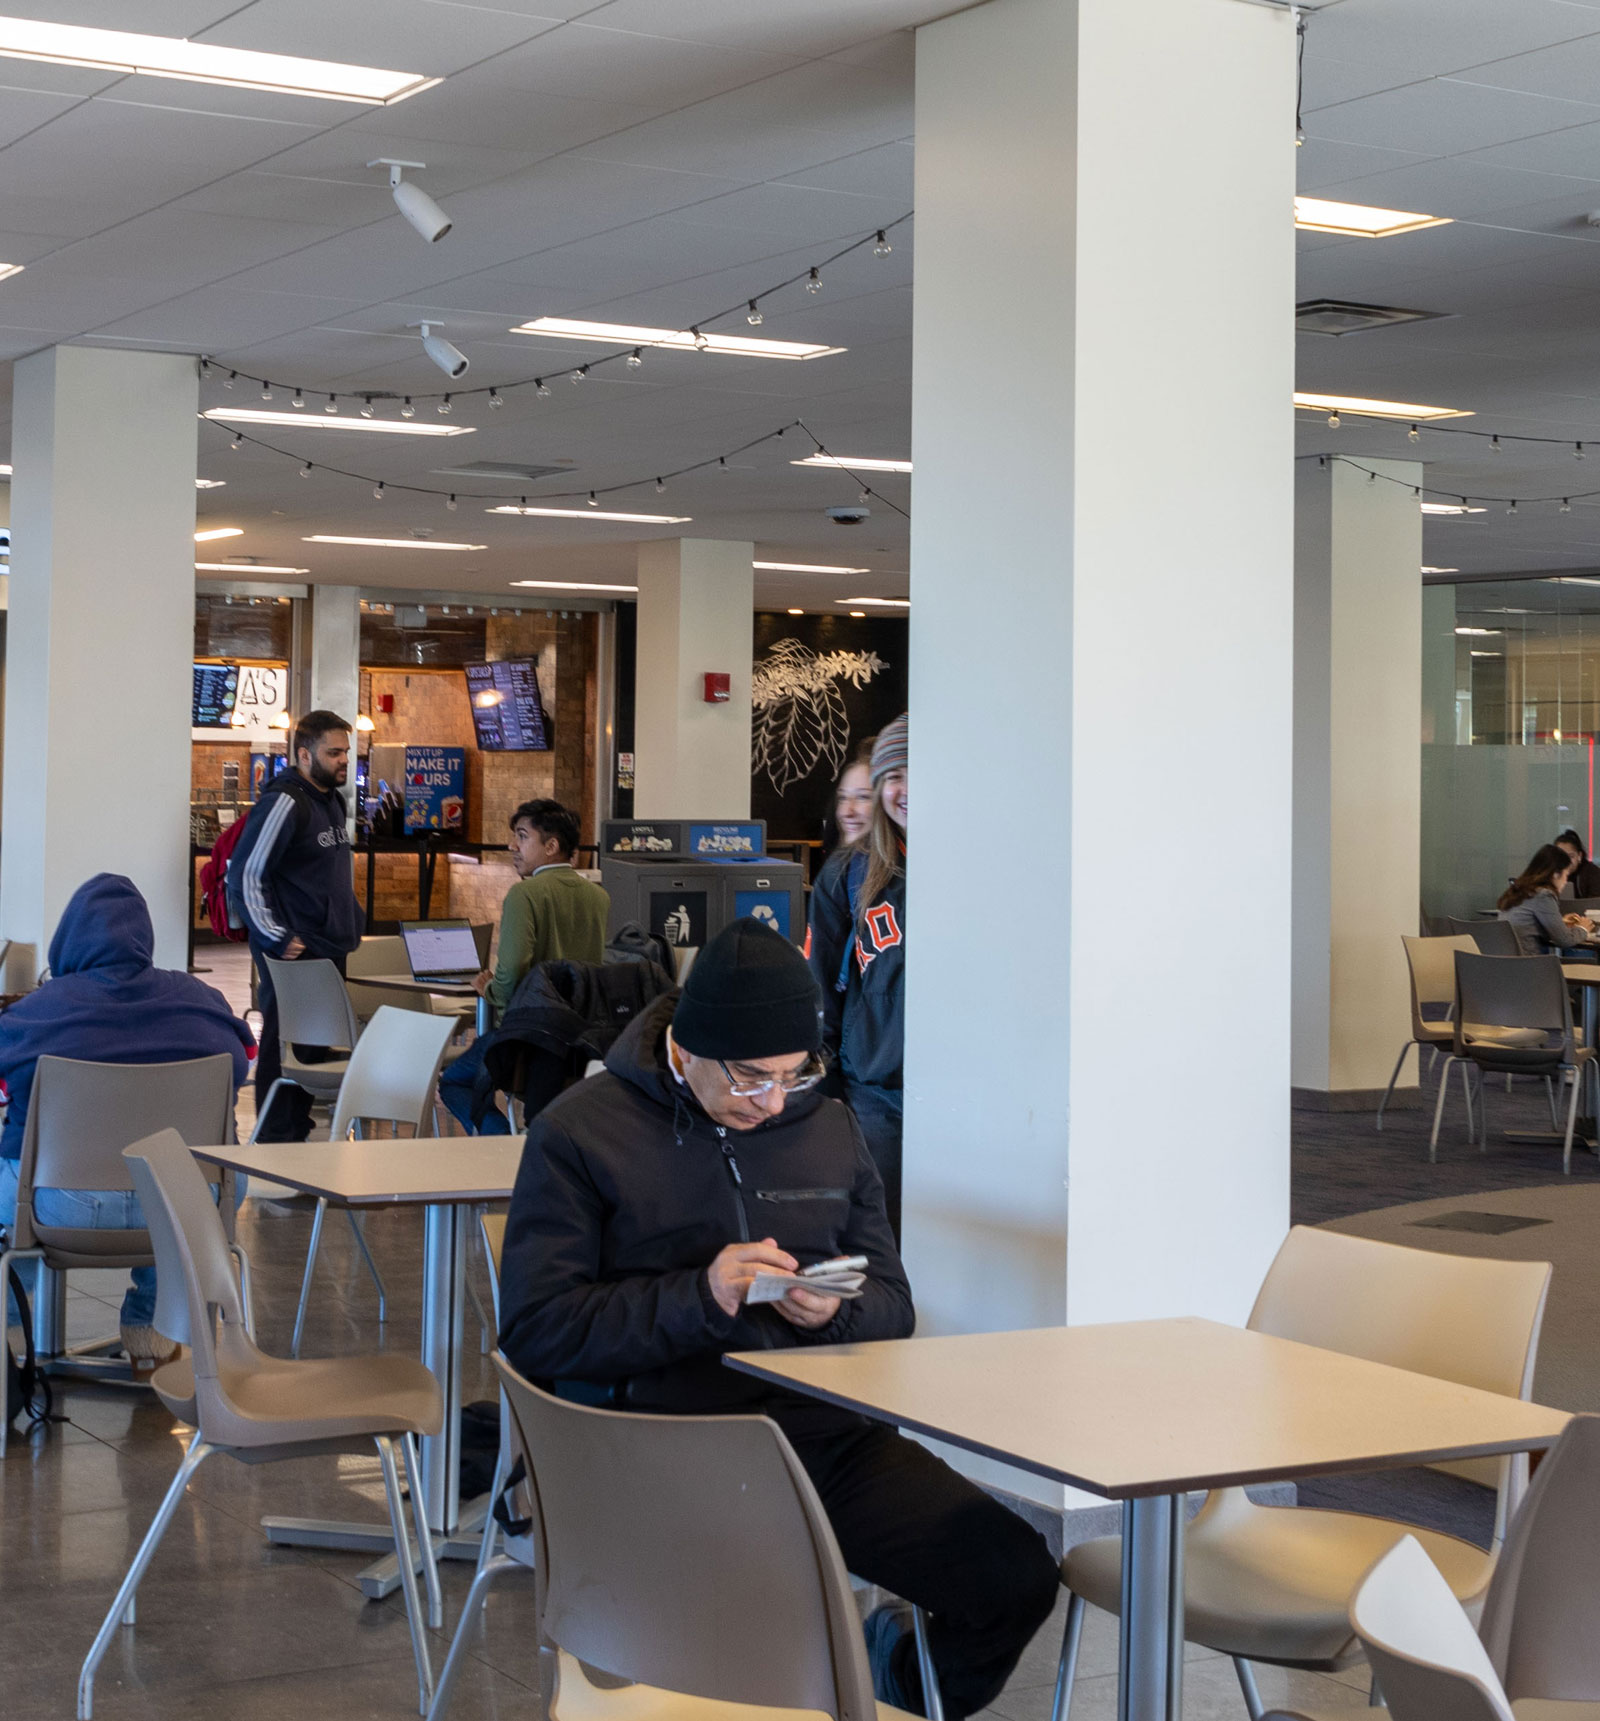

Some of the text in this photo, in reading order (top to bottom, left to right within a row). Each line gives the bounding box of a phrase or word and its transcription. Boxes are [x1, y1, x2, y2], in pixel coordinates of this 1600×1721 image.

[432, 748, 444, 757] UP
[406, 757, 461, 771] MAKE IT
